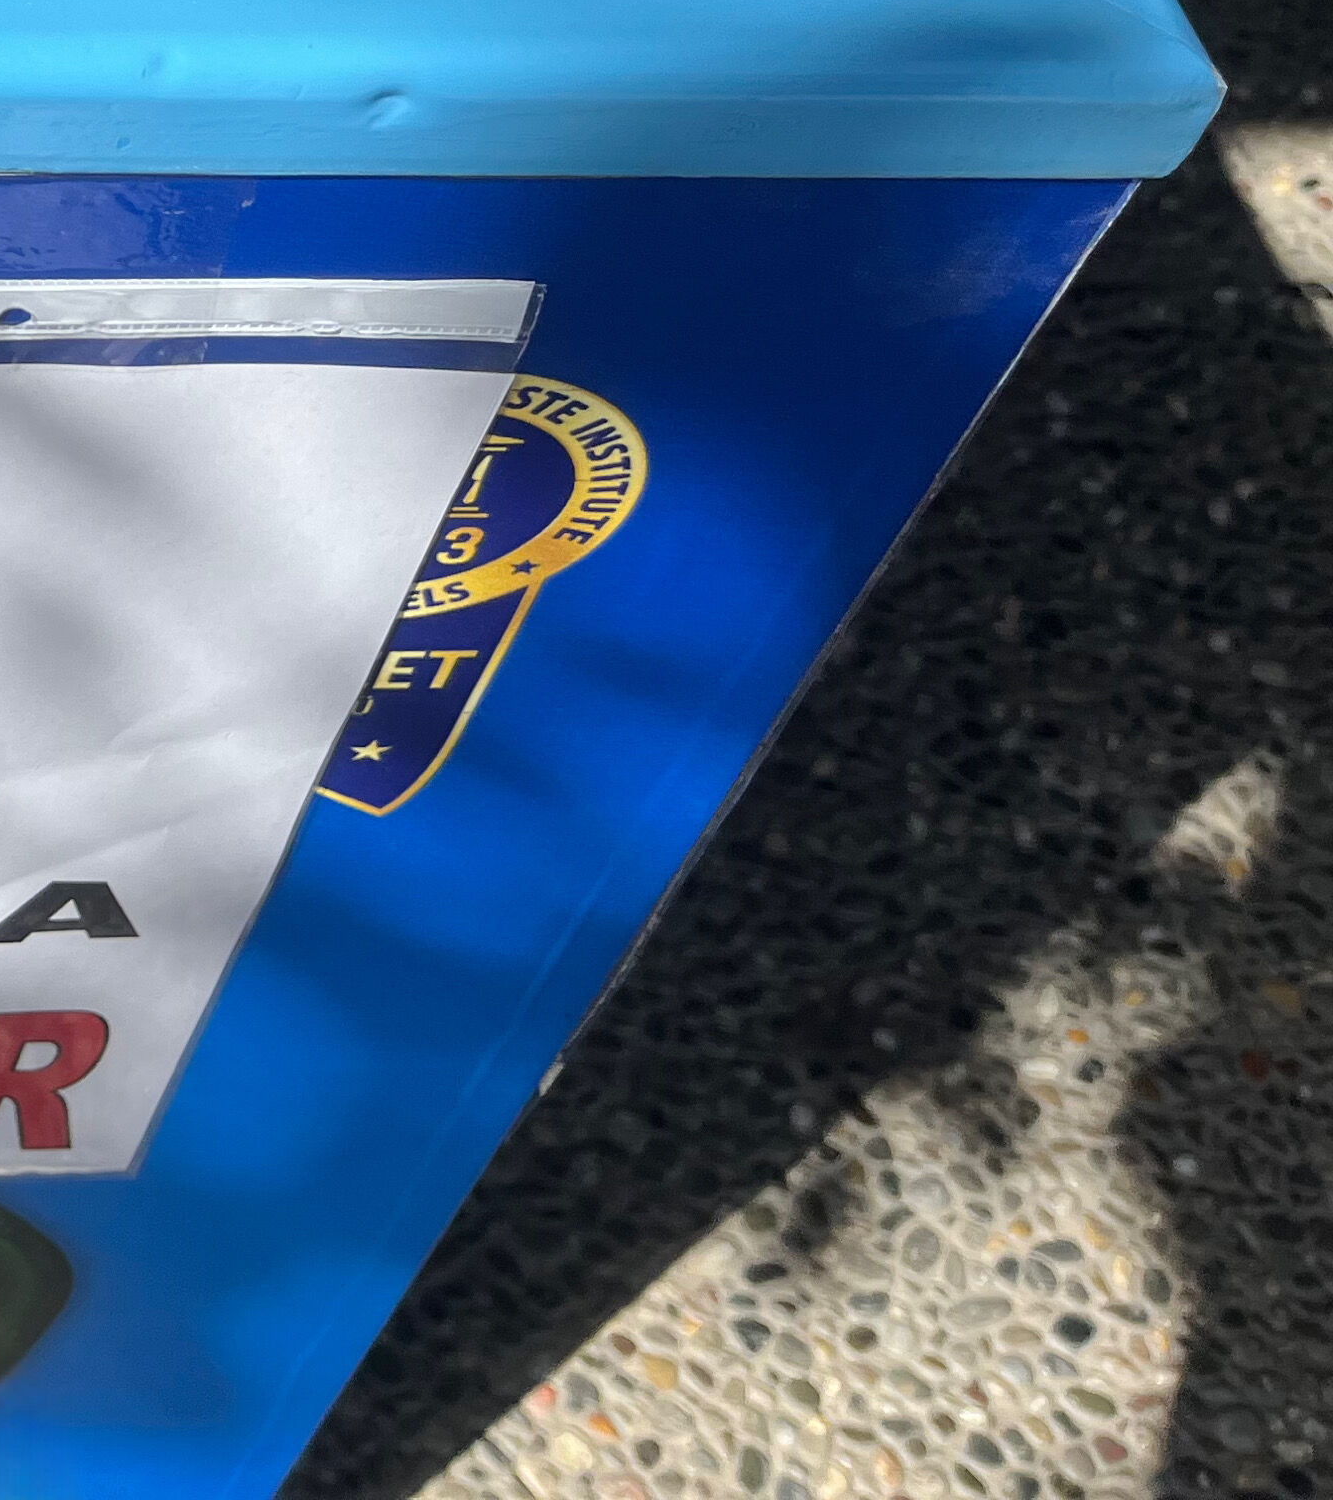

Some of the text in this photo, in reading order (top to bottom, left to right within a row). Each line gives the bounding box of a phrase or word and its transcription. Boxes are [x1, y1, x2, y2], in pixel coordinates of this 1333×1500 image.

[504, 385, 632, 546] STE INSTITUTE
[435, 526, 486, 565] 3
[403, 581, 471, 610] ELS
[372, 650, 480, 690] ET
